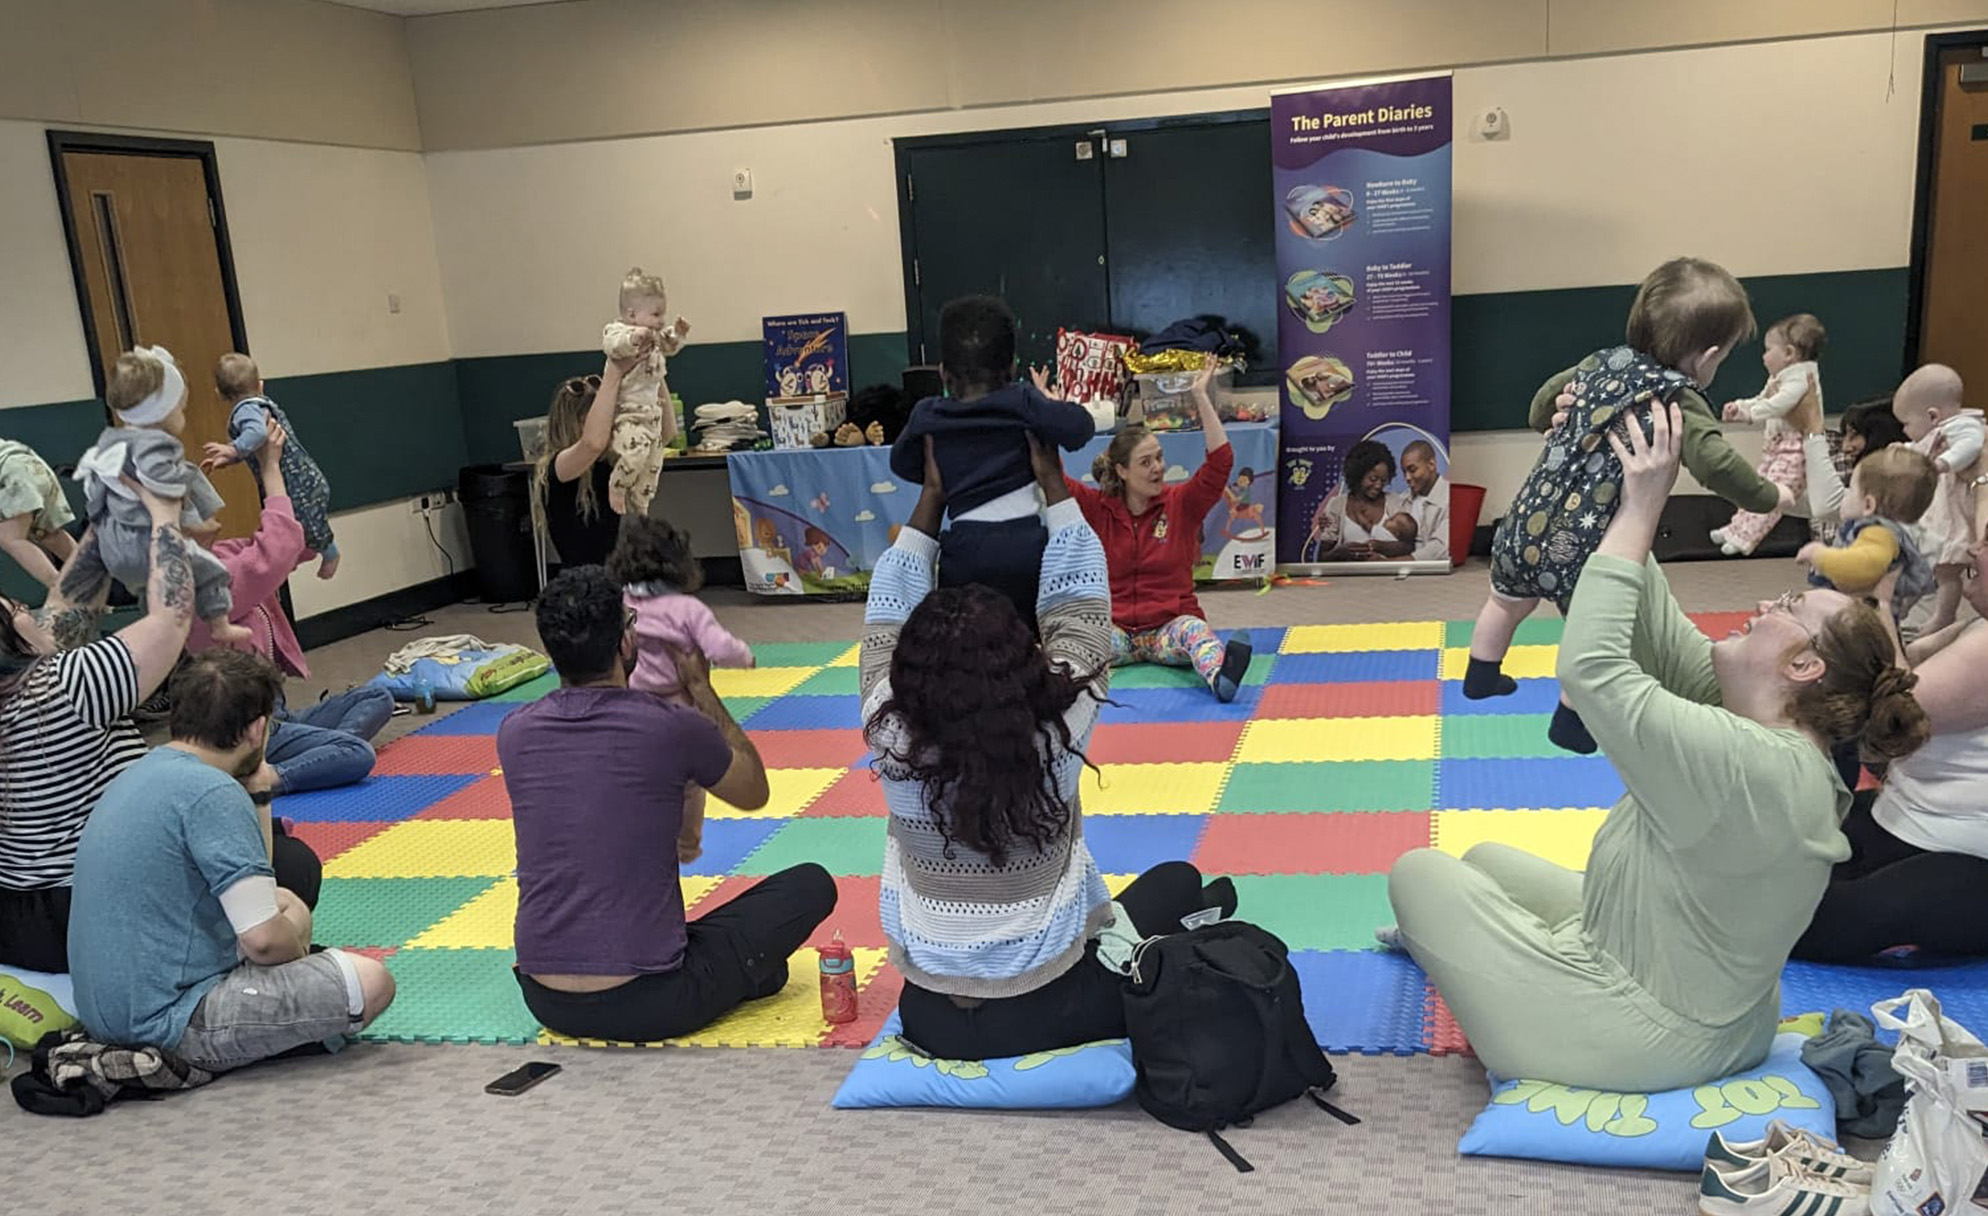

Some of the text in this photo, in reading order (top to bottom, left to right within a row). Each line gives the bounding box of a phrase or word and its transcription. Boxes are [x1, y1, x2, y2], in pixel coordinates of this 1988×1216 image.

[1291, 104, 1433, 132] The Parent Diaries
[1290, 136, 1308, 144] Follow
[1309, 135, 1321, 143] your
[1322, 132, 1340, 141] child's
[1340, 129, 1377, 139] development
[1377, 127, 1391, 135] from
[1392, 126, 1406, 134] birth
[1418, 124, 1434, 132] years
[1396, 349, 1412, 358] Child
[1327, 445, 1336, 453] by
[3, 993, 44, 1024] Learn
